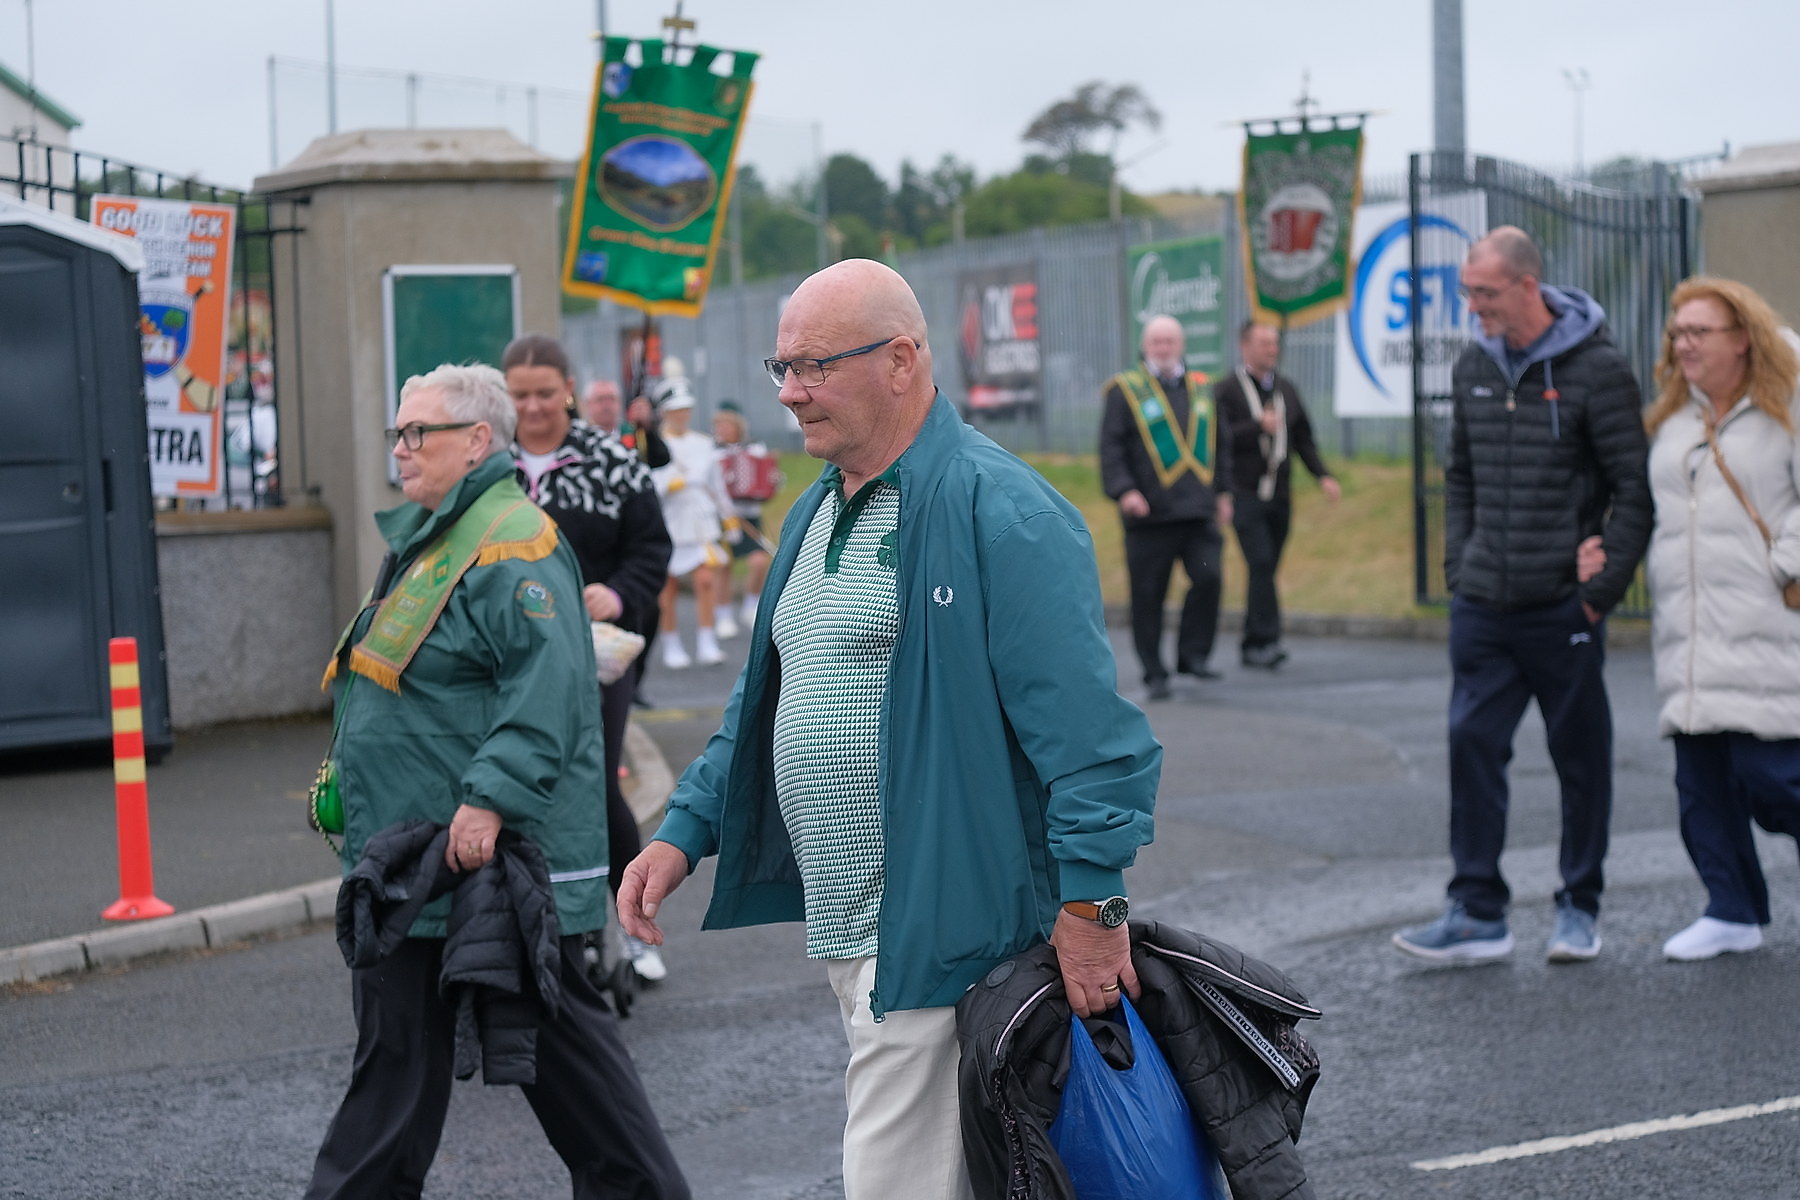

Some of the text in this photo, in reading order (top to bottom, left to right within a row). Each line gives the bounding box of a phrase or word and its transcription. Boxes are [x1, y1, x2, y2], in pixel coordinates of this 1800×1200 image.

[101, 206, 224, 239] GOOD LUCK
[150, 427, 204, 465] TRA
